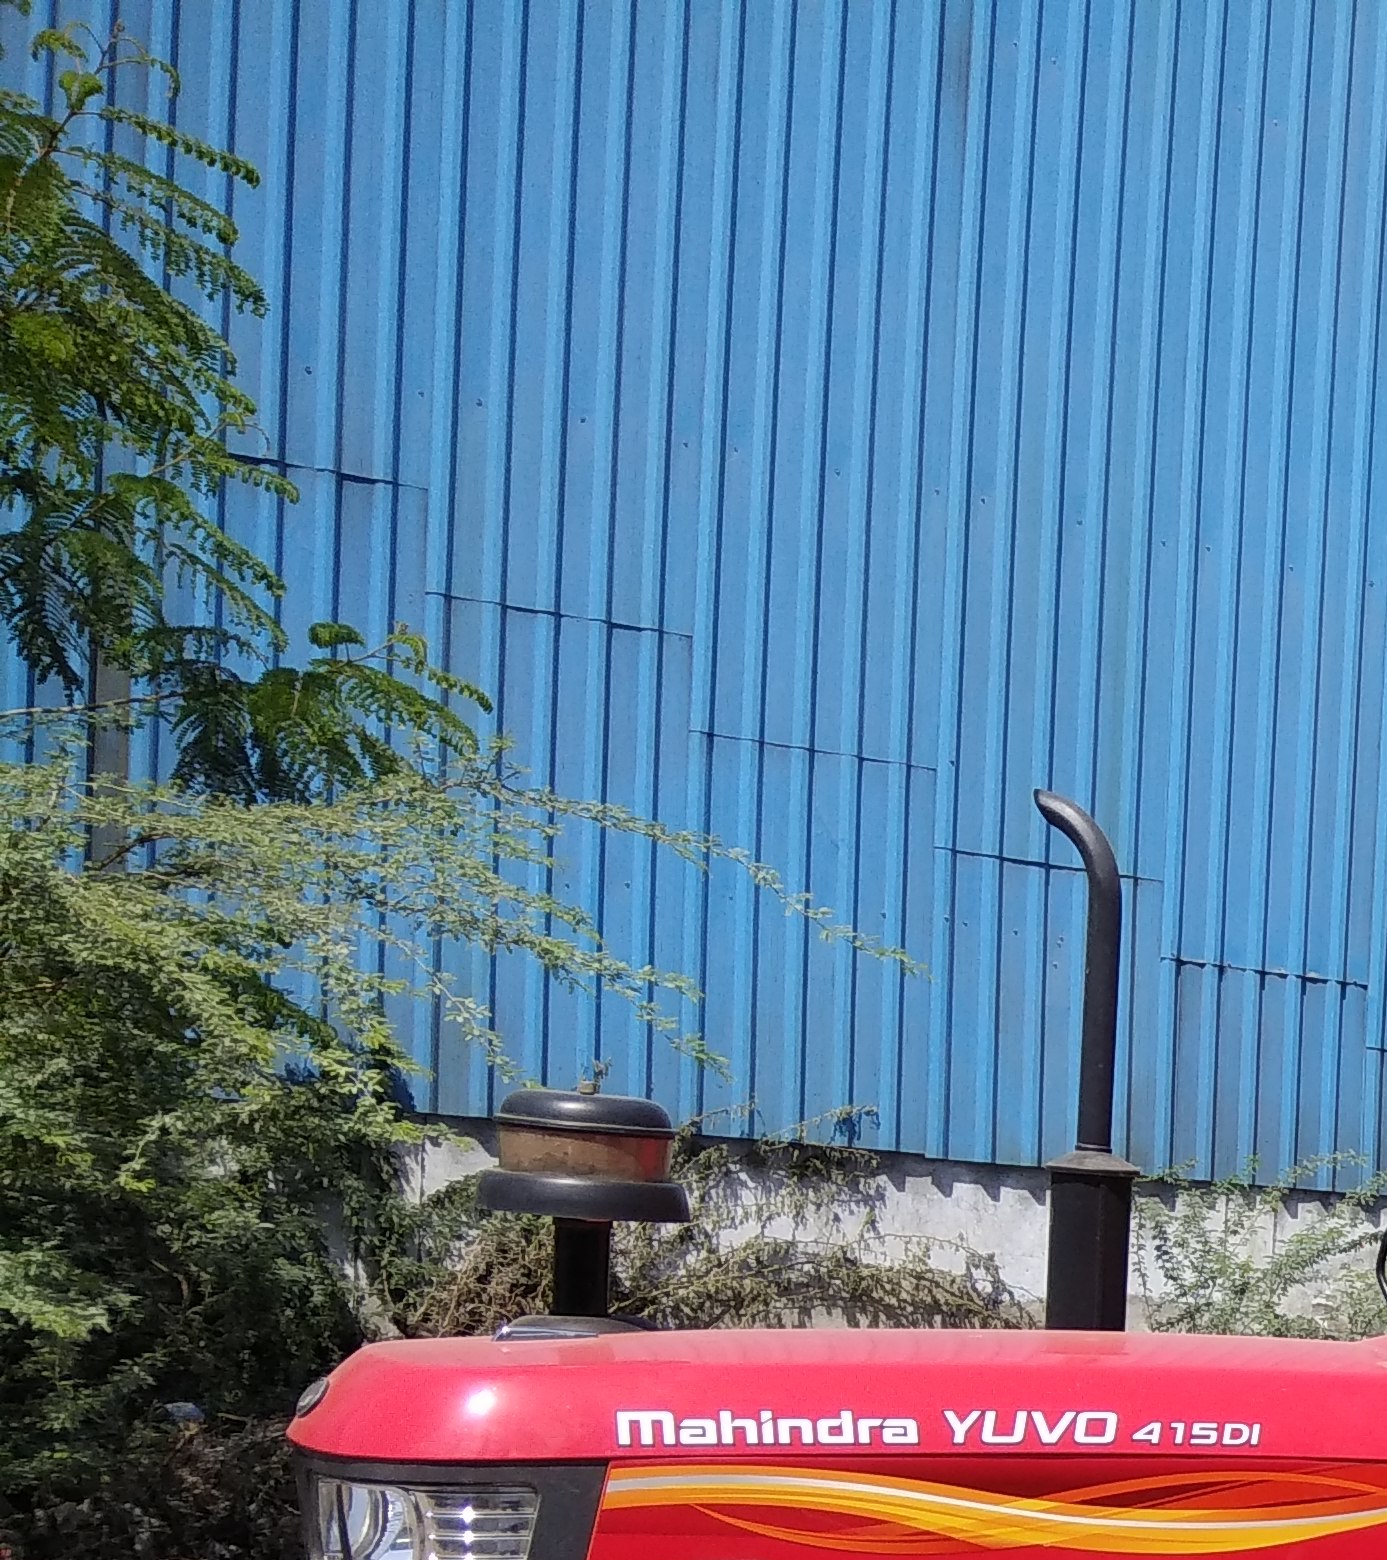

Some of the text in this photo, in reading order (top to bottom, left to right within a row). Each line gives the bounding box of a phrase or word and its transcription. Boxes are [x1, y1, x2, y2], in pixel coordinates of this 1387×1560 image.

[615, 1409, 1262, 1447] Mahindra YUVO 415DI
